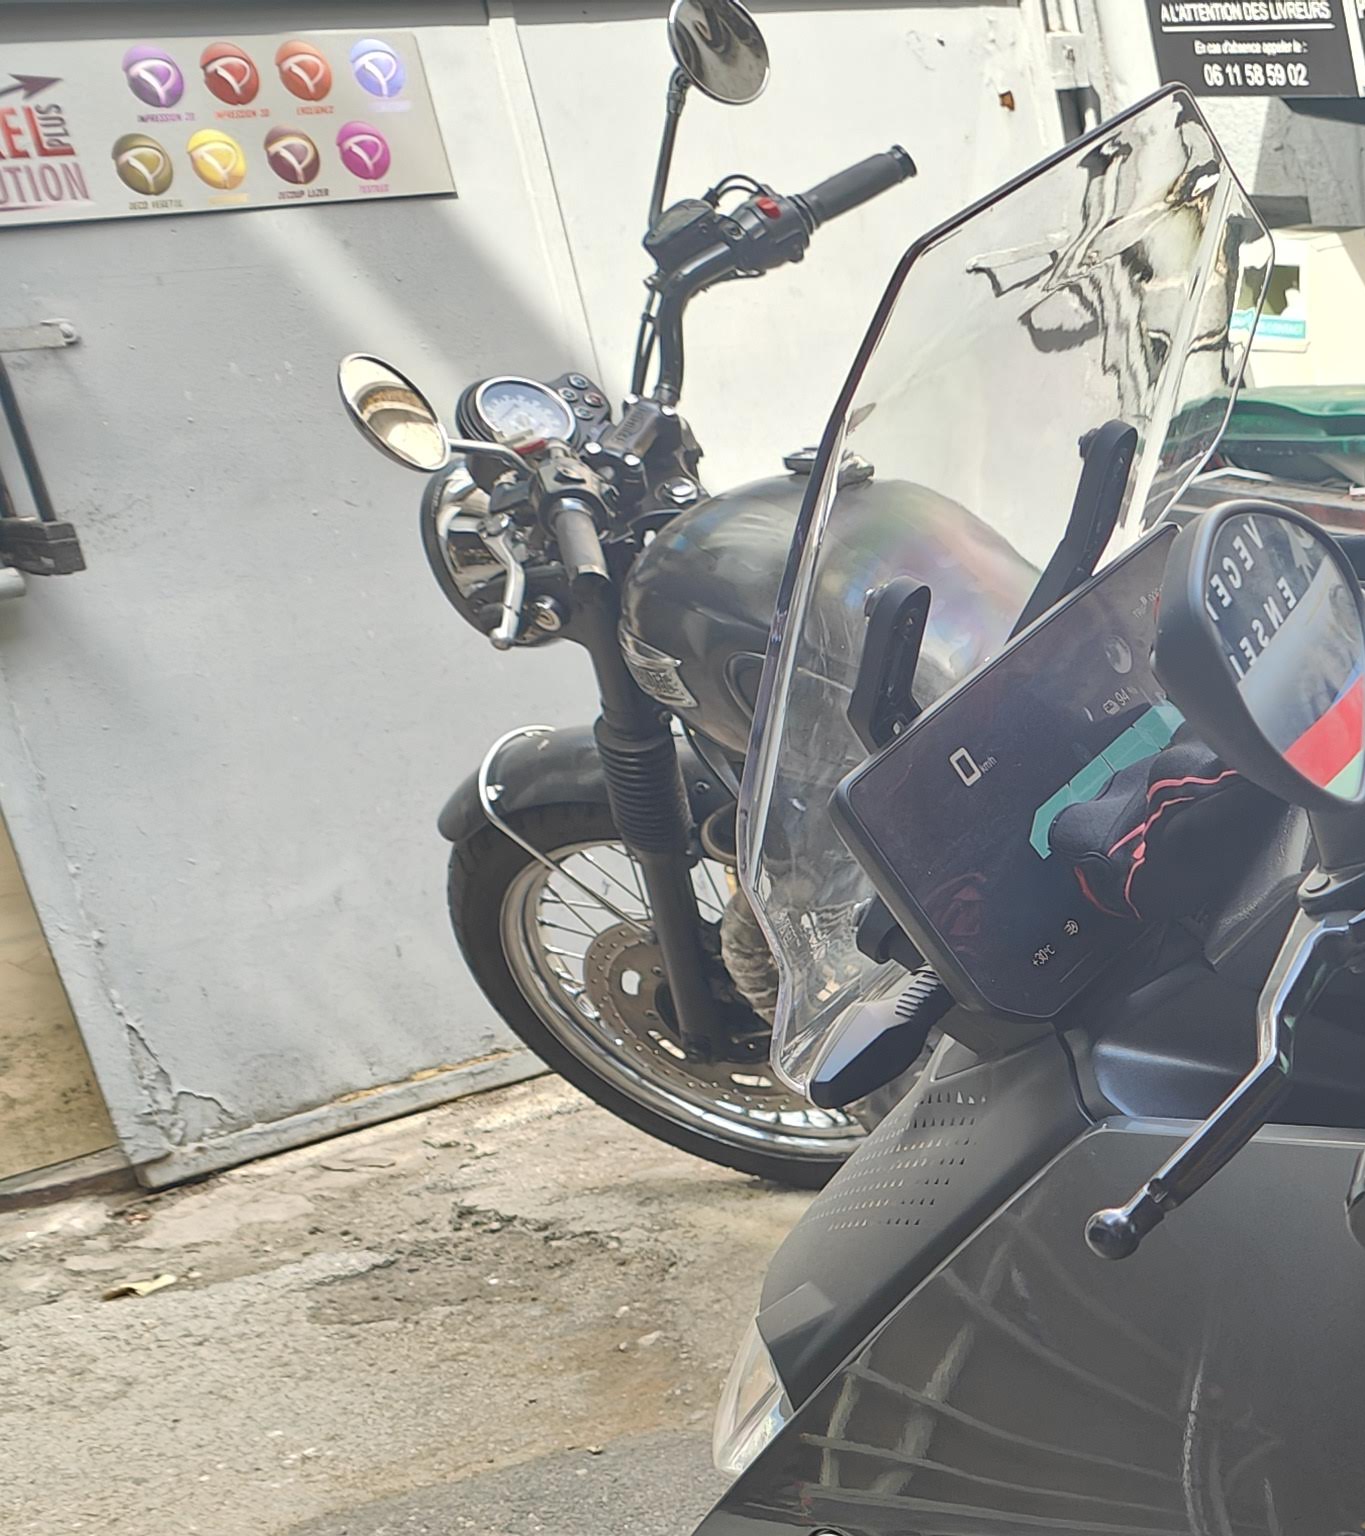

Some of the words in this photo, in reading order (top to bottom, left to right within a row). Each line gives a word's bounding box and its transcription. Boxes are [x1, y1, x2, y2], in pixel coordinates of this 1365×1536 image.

[1243, 2, 1269, 20] DES
[1269, 1, 1332, 19] LIVREURS
[1203, 63, 1224, 86] 06
[1225, 63, 1242, 86] 11
[1244, 63, 1265, 86] 58
[1265, 63, 1286, 86] 59
[1286, 63, 1309, 86] 02
[0, 105, 76, 160] EL
[35, 103, 73, 149] PLUS
[949, 747, 982, 787] 0
